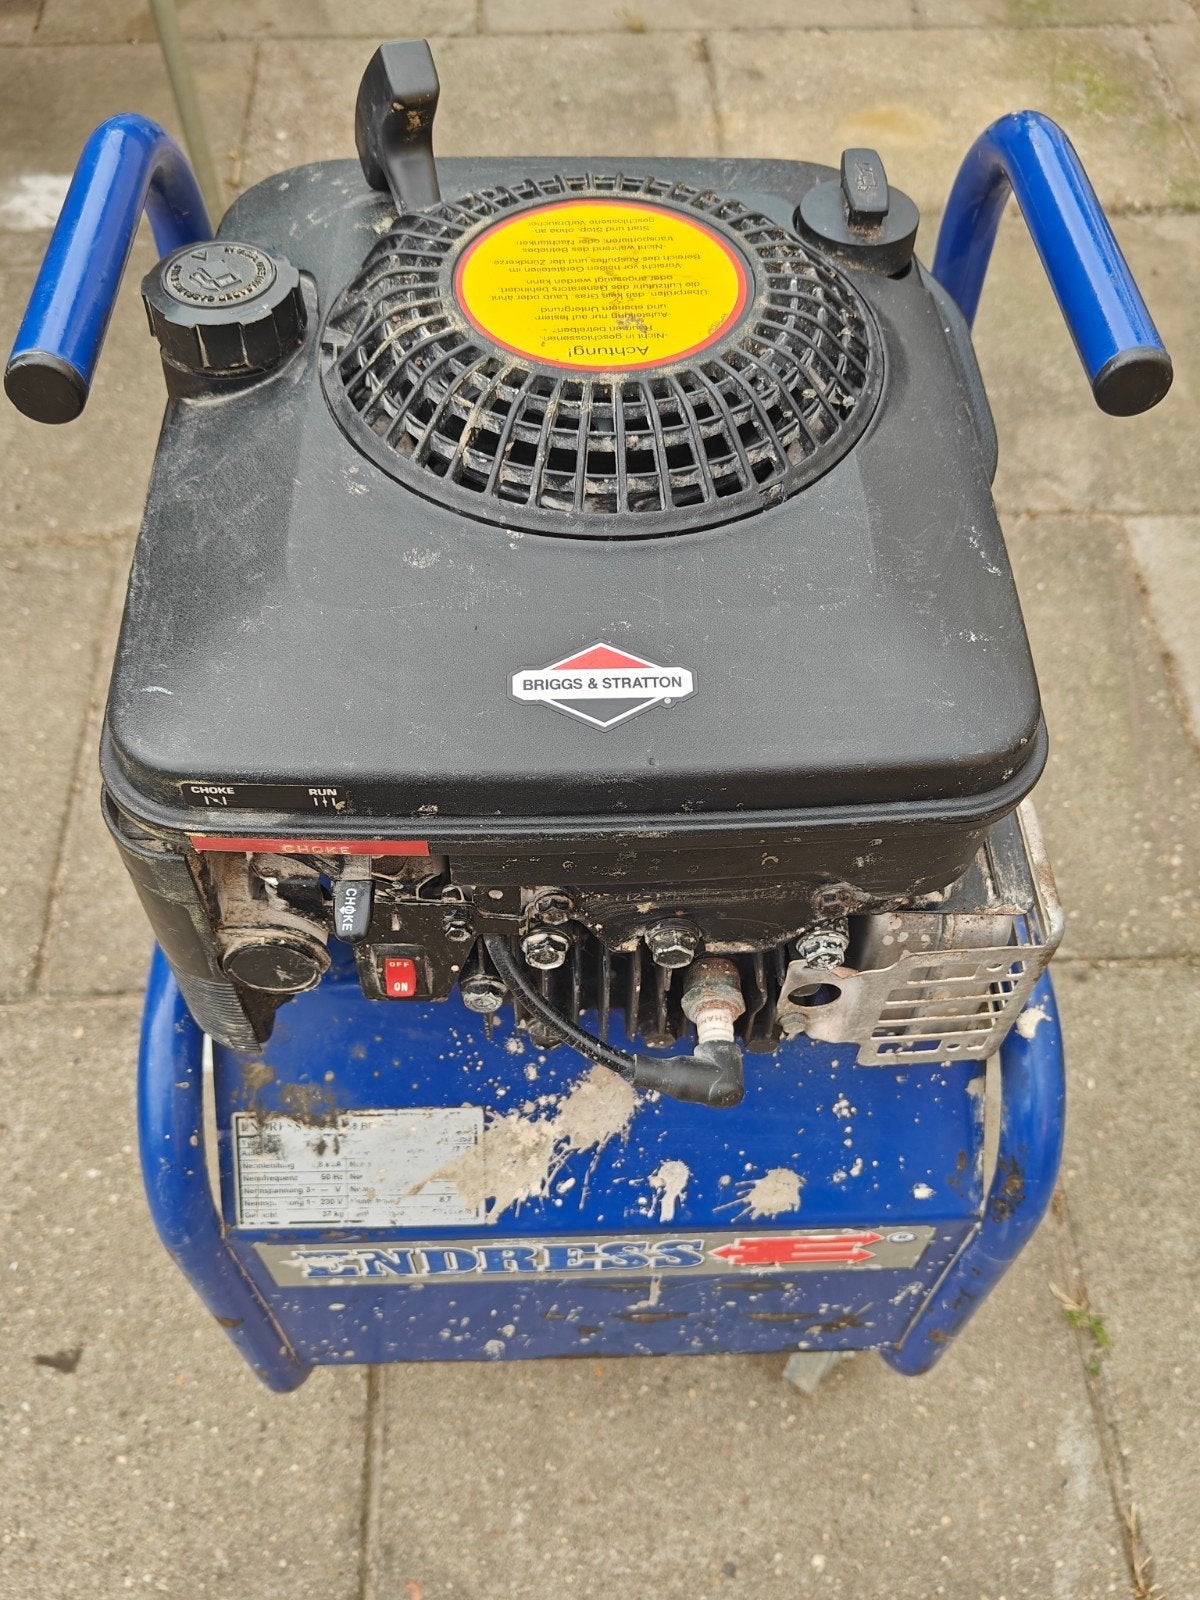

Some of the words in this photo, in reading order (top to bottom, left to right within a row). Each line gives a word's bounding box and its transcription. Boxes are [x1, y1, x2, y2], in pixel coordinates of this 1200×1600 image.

[568, 345, 649, 358] Achtung!
[522, 678, 582, 691] BRIGGS
[588, 678, 598, 689] &
[603, 677, 682, 689] STRATTON
[191, 786, 235, 795] CHOKE
[309, 788, 337, 796] RUN
[281, 845, 352, 855] CHOKE
[341, 887, 357, 932] CHOKE
[394, 981, 409, 992] ON
